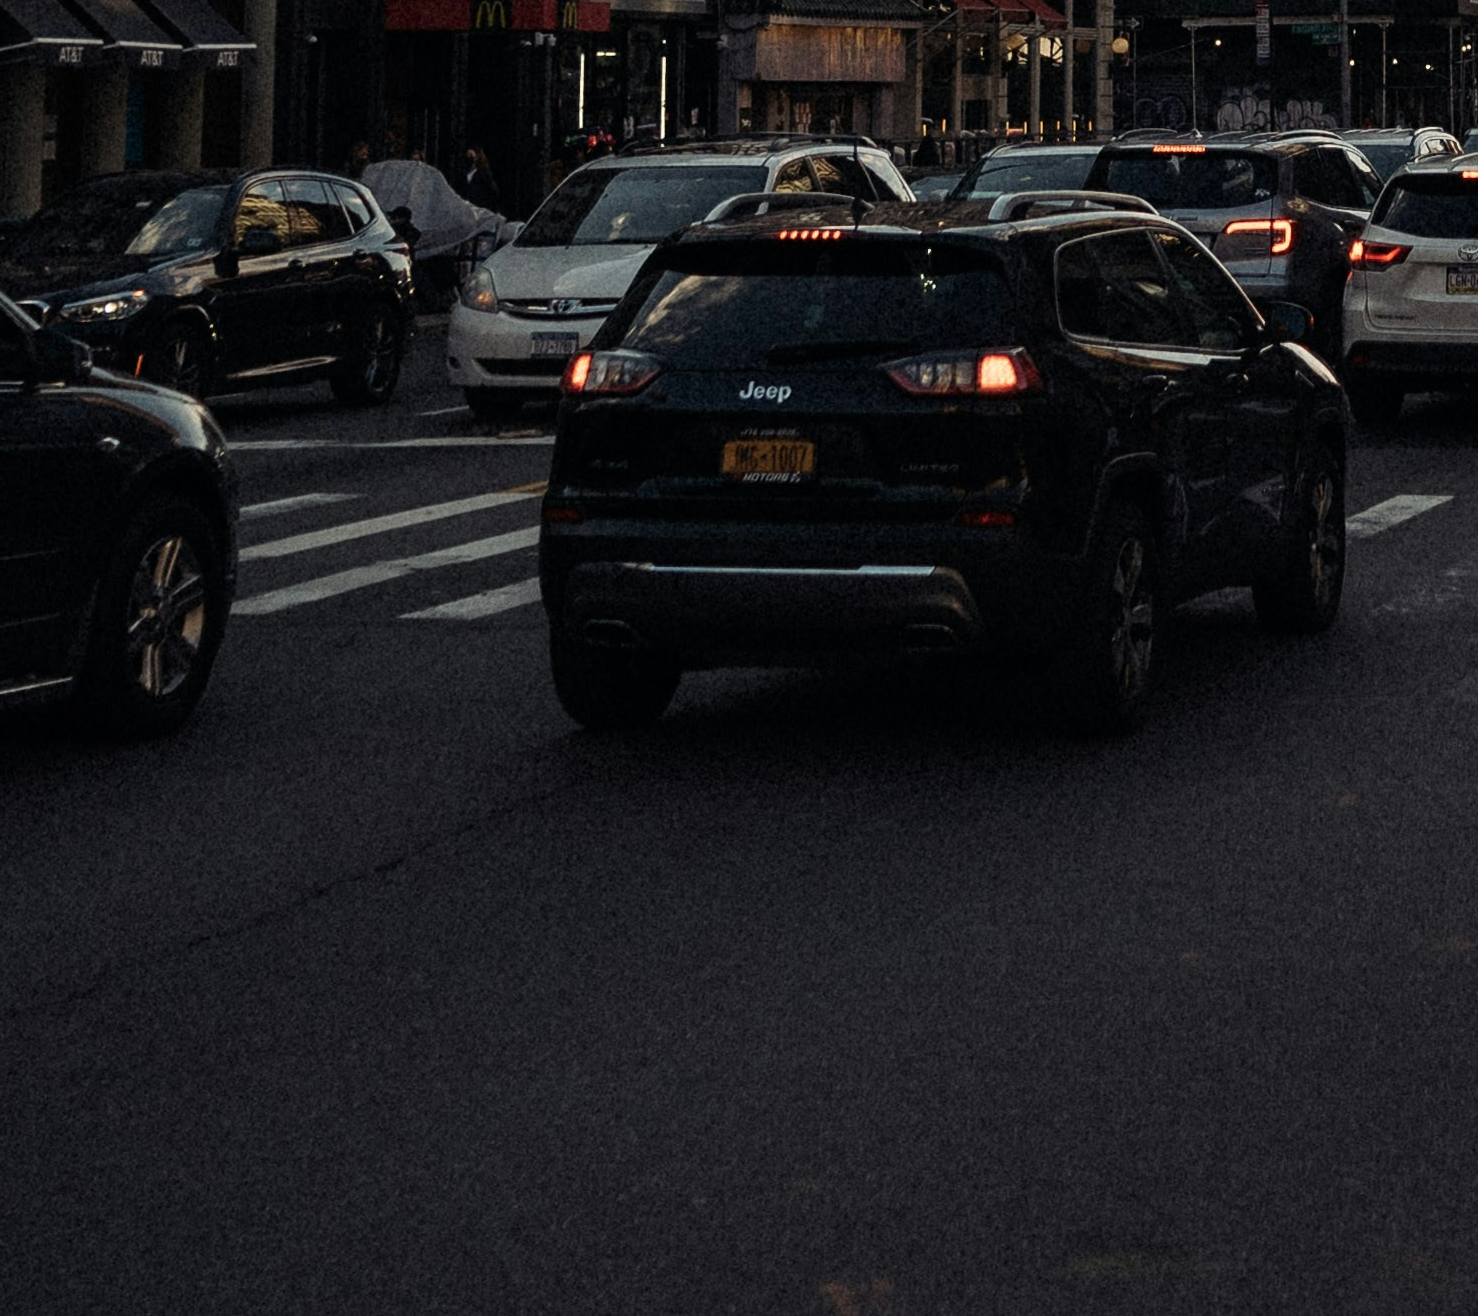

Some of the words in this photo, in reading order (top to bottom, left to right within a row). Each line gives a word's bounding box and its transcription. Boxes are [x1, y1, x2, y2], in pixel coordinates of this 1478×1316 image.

[59, 47, 84, 64] AT&T
[141, 51, 163, 67] AT&T
[217, 52, 239, 68] AT&T
[739, 381, 792, 404] Jeep
